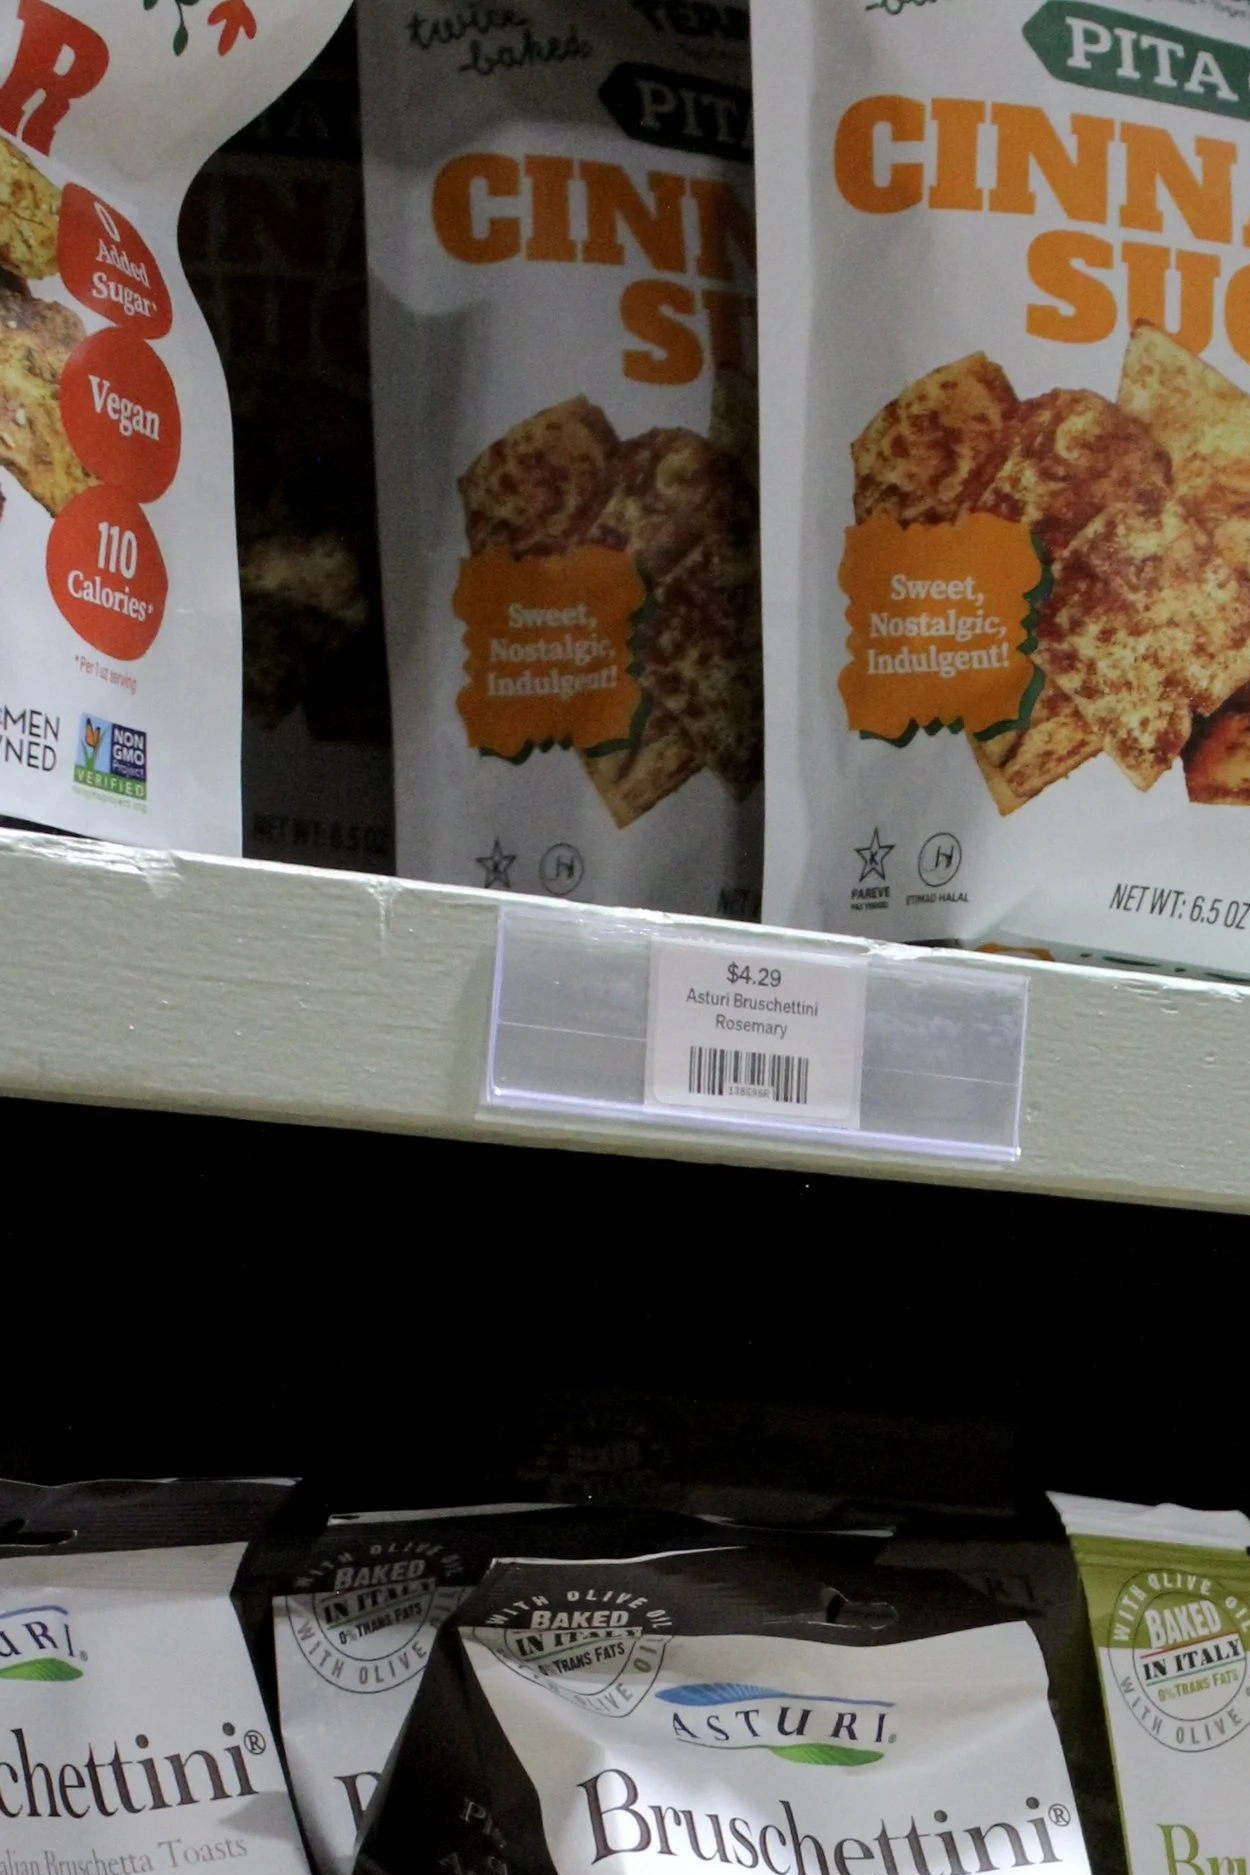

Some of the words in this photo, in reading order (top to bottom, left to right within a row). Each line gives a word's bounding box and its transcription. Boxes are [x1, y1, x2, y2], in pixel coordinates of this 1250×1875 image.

[1065, 15, 1239, 101] PITA
[94, 201, 121, 242] 0
[96, 238, 151, 289] Added
[88, 375, 161, 441] Vegan
[98, 522, 138, 579] 110
[890, 574, 984, 604] Sweet,
[508, 603, 598, 629] Sweet,
[869, 611, 1006, 642] Nostalgic,
[490, 632, 616, 664] Nostalgic,
[867, 645, 1010, 676] Indulgent!
[487, 665, 618, 701] Indulgent!
[114, 728, 144, 750] NON
[113, 745, 145, 766] GMO
[77, 770, 145, 797] VERIFIED
[851, 886, 890, 900] PAREVE
[1109, 883, 1149, 913] NET
[1148, 888, 1187, 918] WT:
[1189, 894, 1220, 924] 6.5
[1223, 901, 1249, 931] OZ
[726, 962, 783, 987] $4.29
[686, 988, 731, 1007] Asturi
[733, 993, 818, 1017] Bruschettini
[715, 1013, 788, 1040] Rosemary
[334, 1559, 426, 1590] BAKED
[357, 1614, 391, 1638] TRANS
[394, 1602, 422, 1624] FATS
[485, 1594, 550, 1625] WITH
[566, 1589, 648, 1609] OLIVE
[645, 1608, 673, 1629] OIL
[530, 1610, 630, 1630] BAKED
[1114, 1580, 1149, 1642] WITH
[1147, 1574, 1212, 1598] OLIVE
[1145, 1600, 1222, 1650] BAKED
[297, 1620, 346, 1679] WITH
[359, 1640, 427, 1685] OLIVE
[515, 1634, 545, 1657] IN
[553, 1651, 593, 1675] TRANS
[595, 1641, 625, 1663] FATS
[1143, 1659, 1167, 1681] IN
[1173, 1637, 1243, 1672] ITALY
[1174, 1677, 1210, 1698] TRANS
[1211, 1668, 1239, 1690] FATS
[1120, 1675, 1163, 1736] WITH
[1175, 1707, 1244, 1745] OLIVE
[158, 1837, 248, 1869] Toasts
